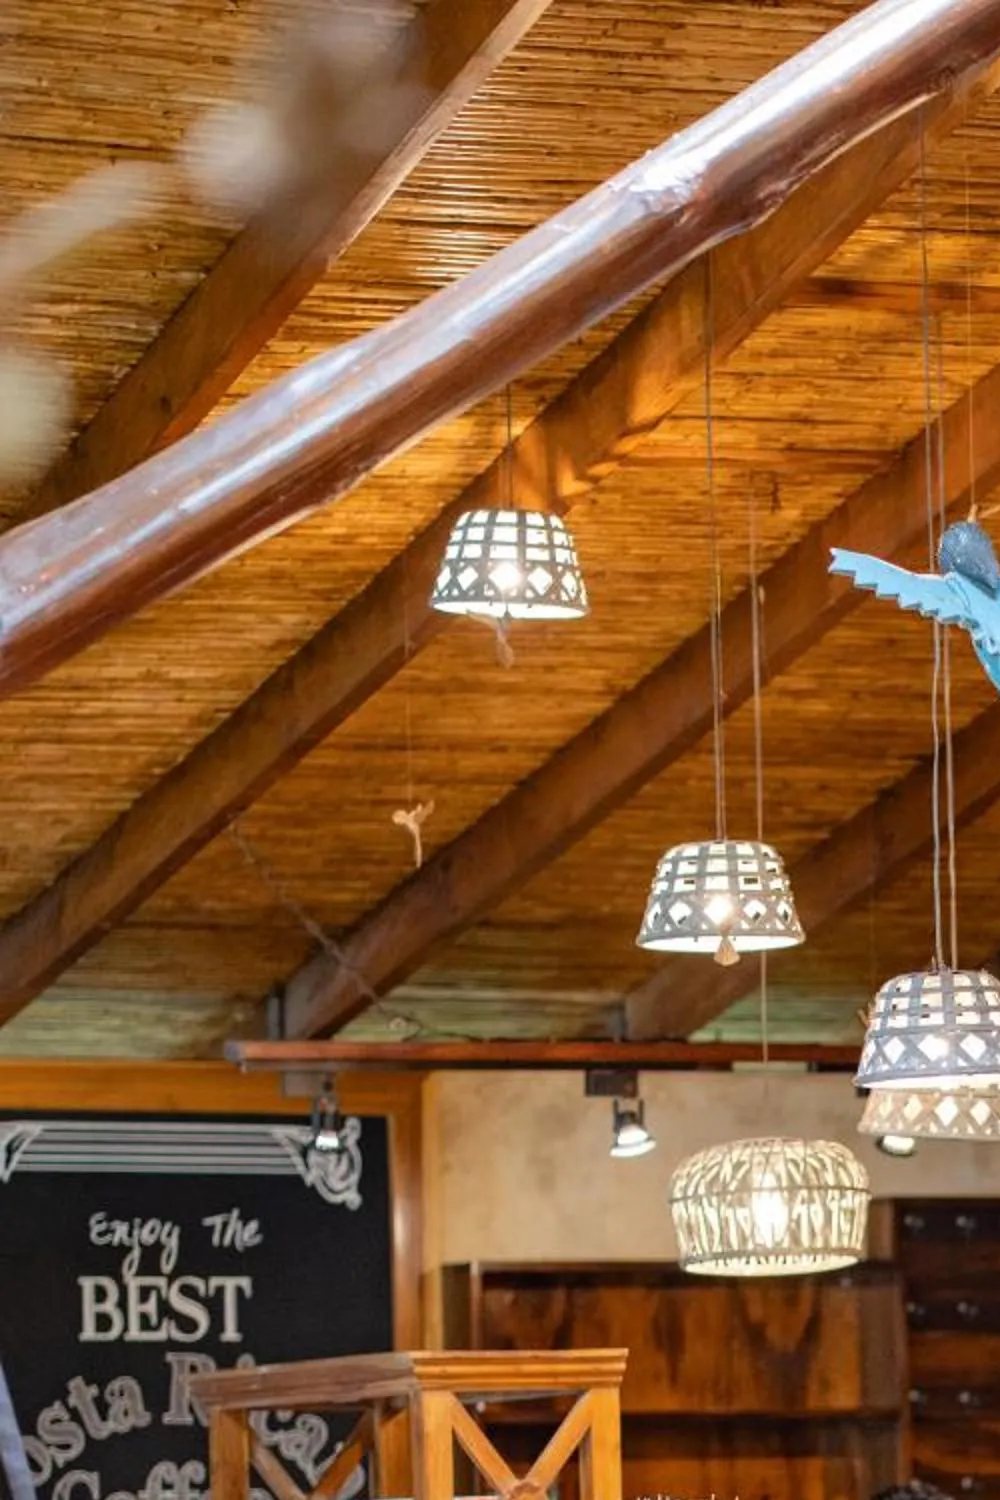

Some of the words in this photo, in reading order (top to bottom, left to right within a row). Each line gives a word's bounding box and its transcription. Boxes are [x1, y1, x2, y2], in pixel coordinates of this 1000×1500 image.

[88, 1211, 181, 1274] Enjoy
[202, 1207, 263, 1250] The
[77, 1275, 252, 1342] BEST
